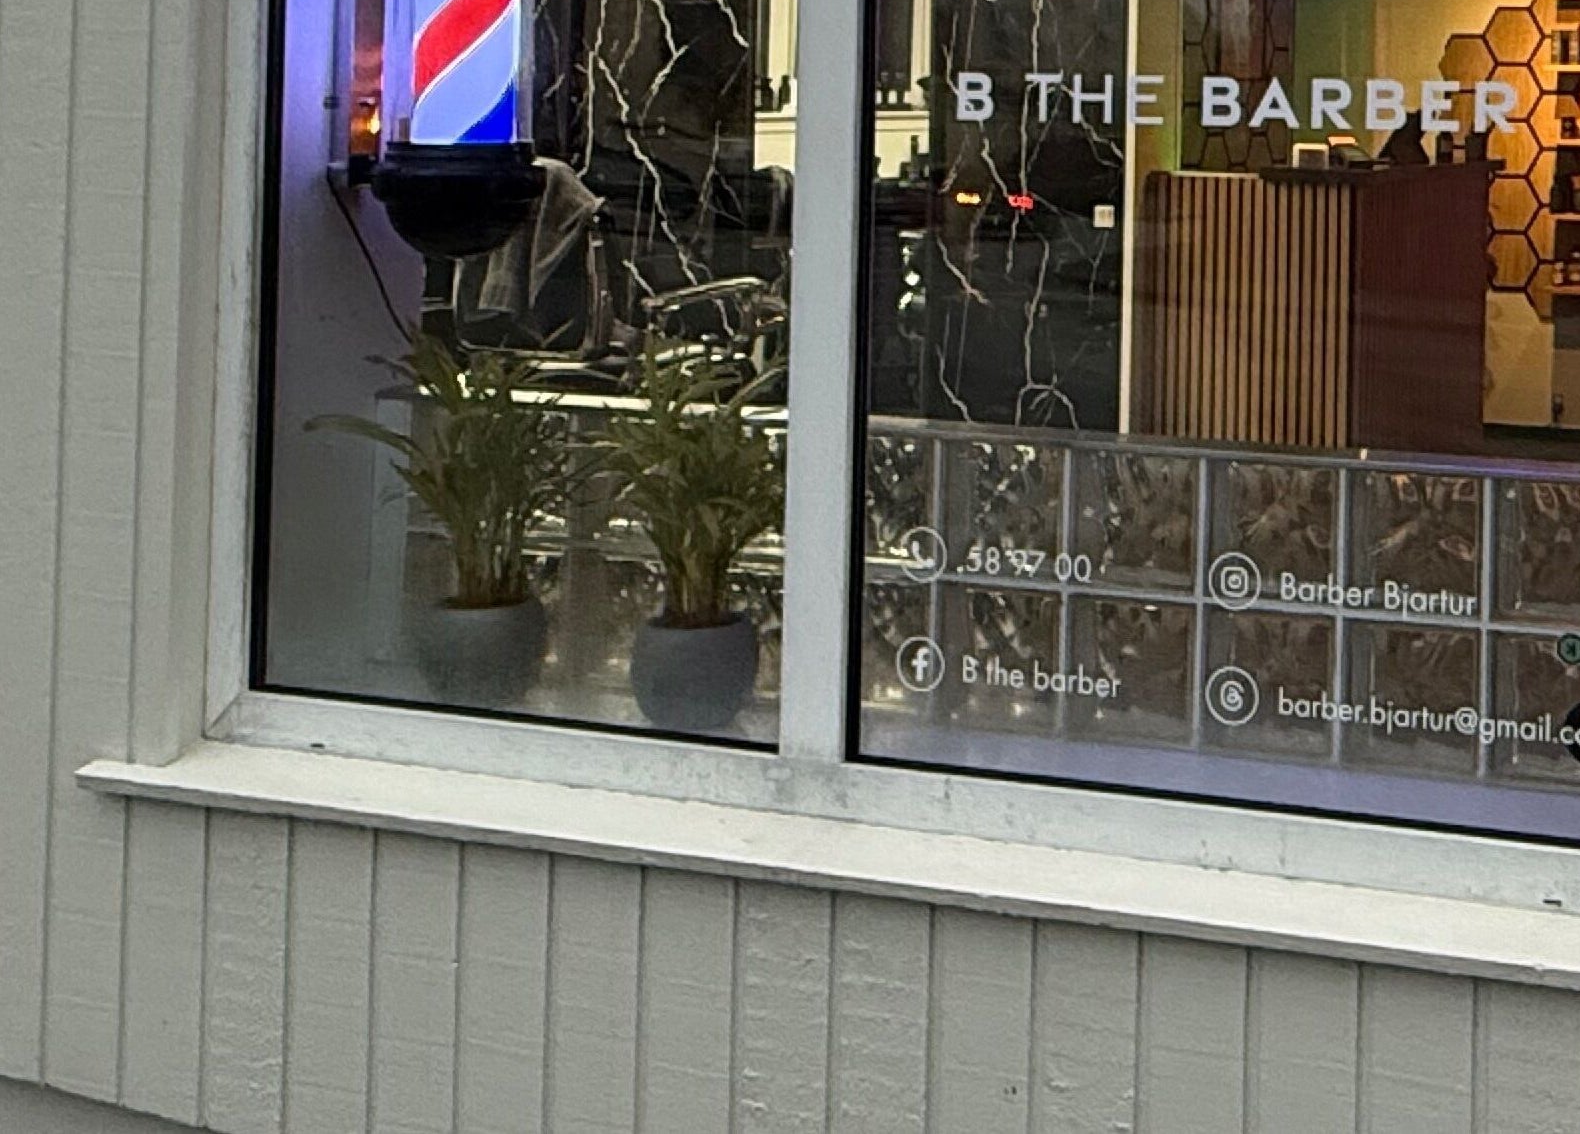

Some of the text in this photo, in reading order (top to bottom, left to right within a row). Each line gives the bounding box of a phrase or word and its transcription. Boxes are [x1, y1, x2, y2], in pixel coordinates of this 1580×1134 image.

[955, 72, 1518, 134] B THE BARBER
[1054, 552, 1092, 582] 00
[1280, 571, 1477, 619] Barber Bjartur
[962, 654, 1121, 698] B the barber
